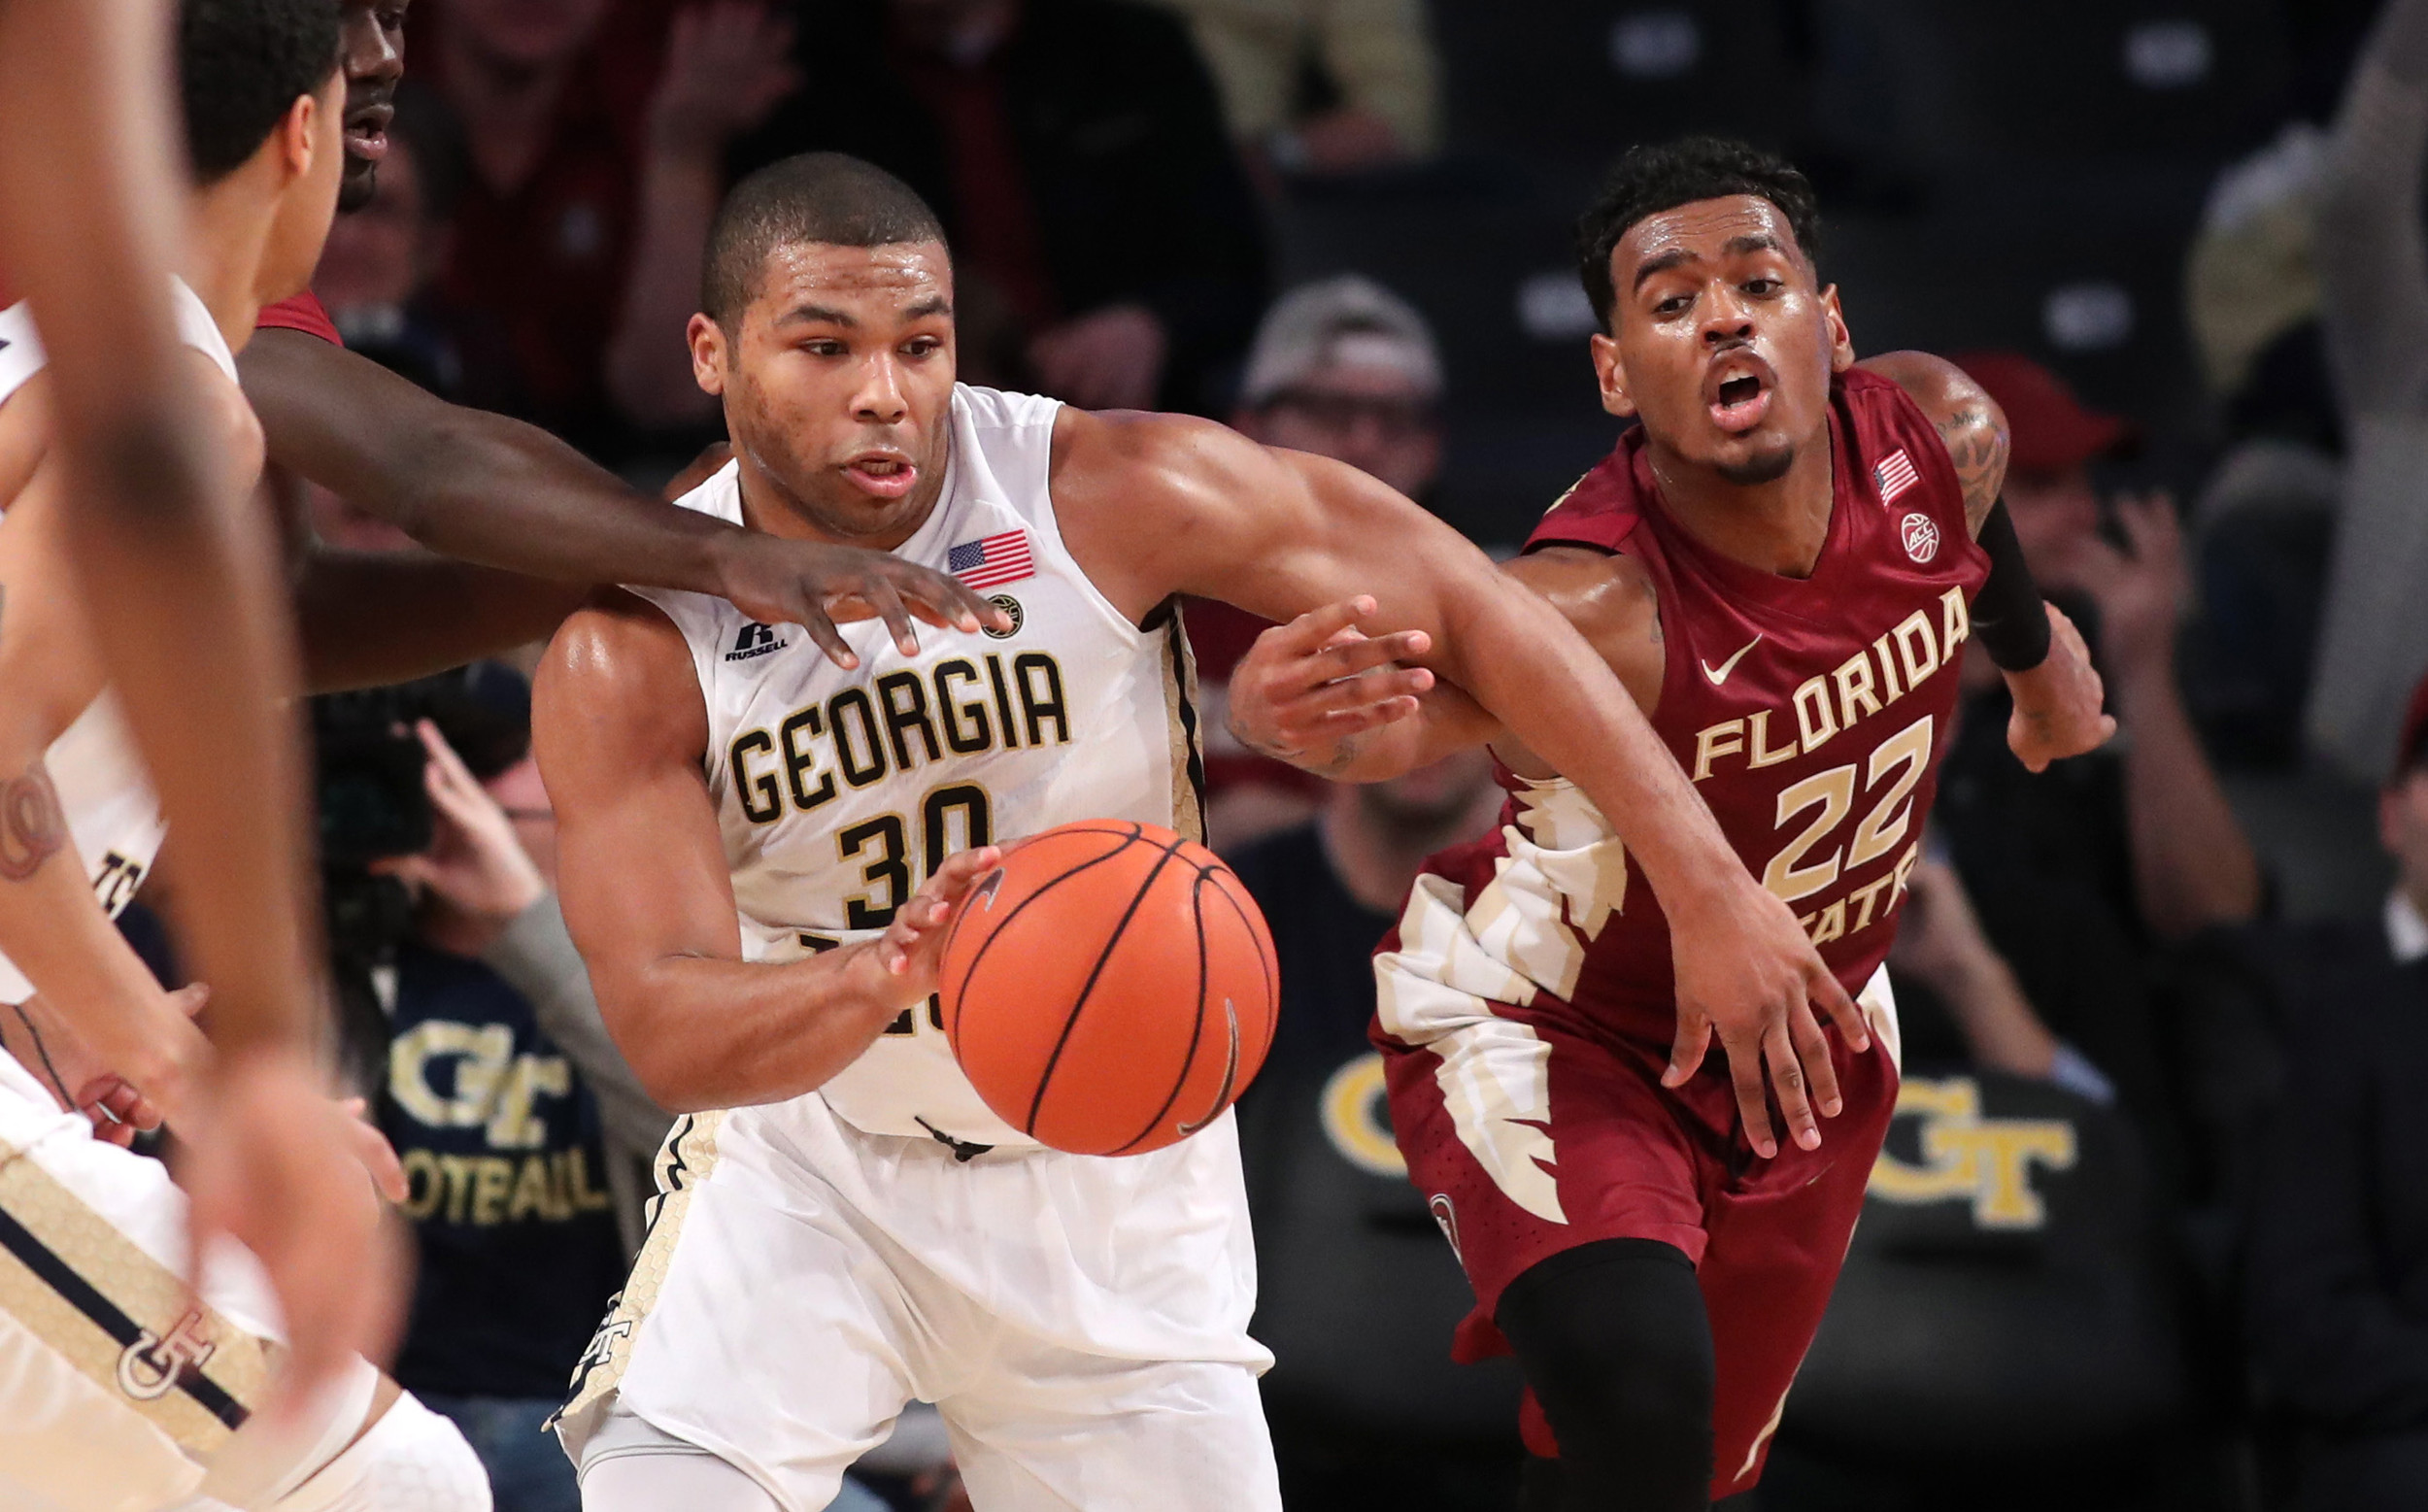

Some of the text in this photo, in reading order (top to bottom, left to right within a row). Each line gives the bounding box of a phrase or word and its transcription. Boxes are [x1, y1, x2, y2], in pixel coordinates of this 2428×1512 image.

[1909, 519, 1934, 548] ACC
[725, 638, 788, 661] RUSSELL
[1692, 585, 1970, 783] FLORIDA
[730, 650, 1073, 824] GEORGIA
[834, 779, 995, 931] 30
[1762, 714, 1933, 924] 22
[389, 1019, 570, 1149] GT
